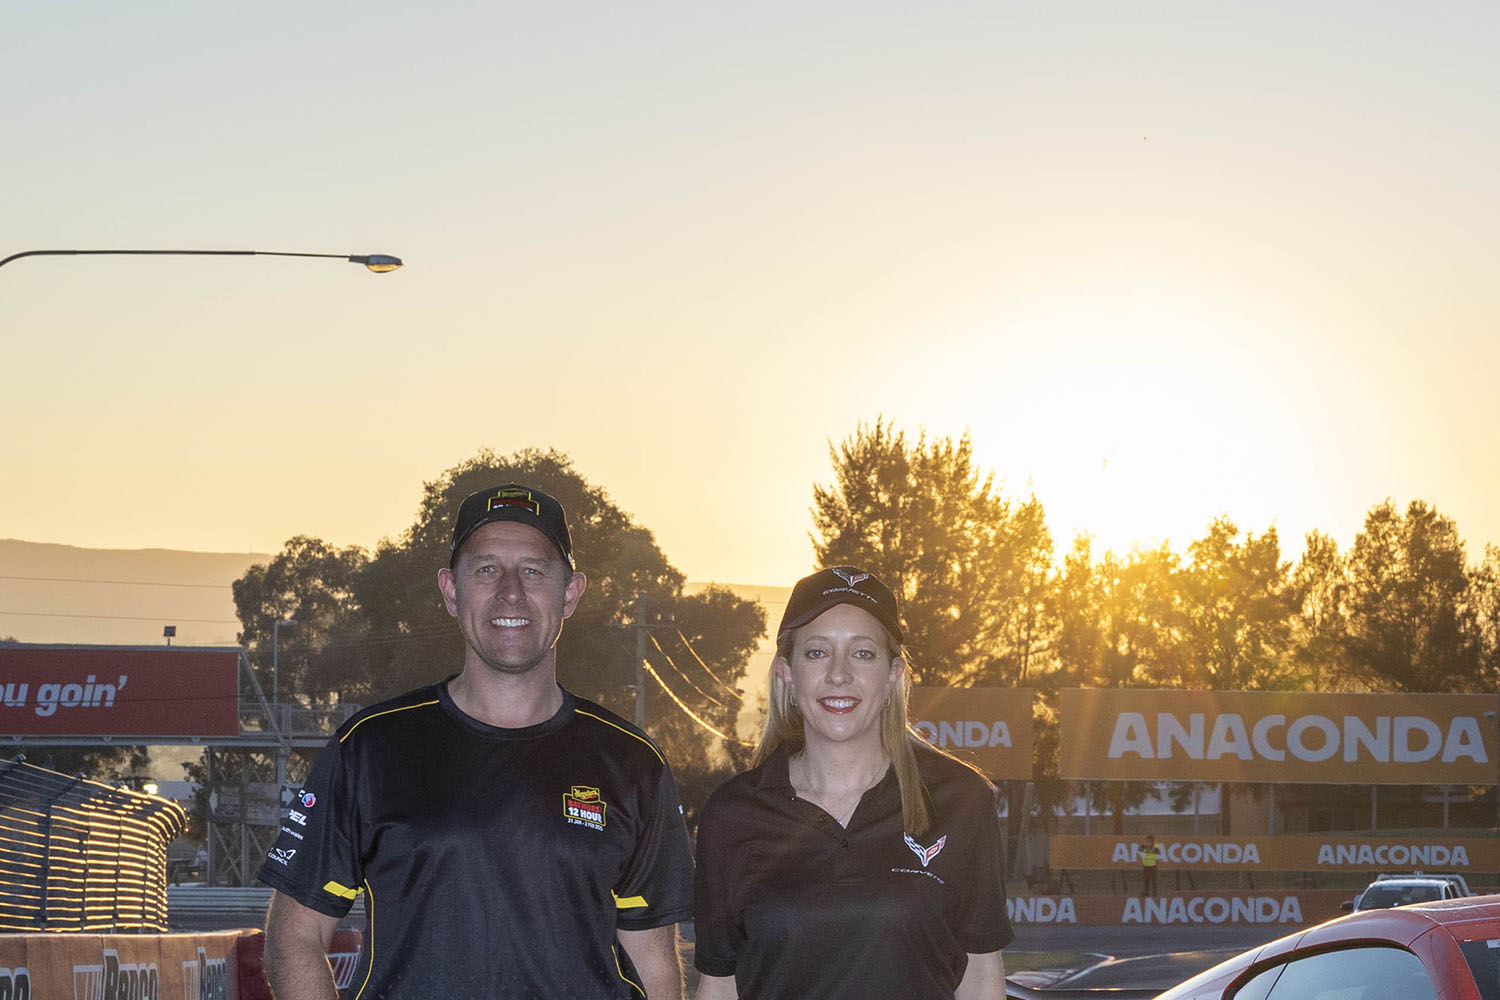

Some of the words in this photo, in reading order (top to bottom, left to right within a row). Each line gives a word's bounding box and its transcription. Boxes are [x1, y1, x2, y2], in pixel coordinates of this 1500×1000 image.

[1107, 712, 1489, 763] ANACONDA
[568, 807, 580, 817] 12
[580, 810, 603, 823] HOUR
[1317, 844, 1469, 867] ANACONDA
[1121, 896, 1303, 923] ANACONDA
